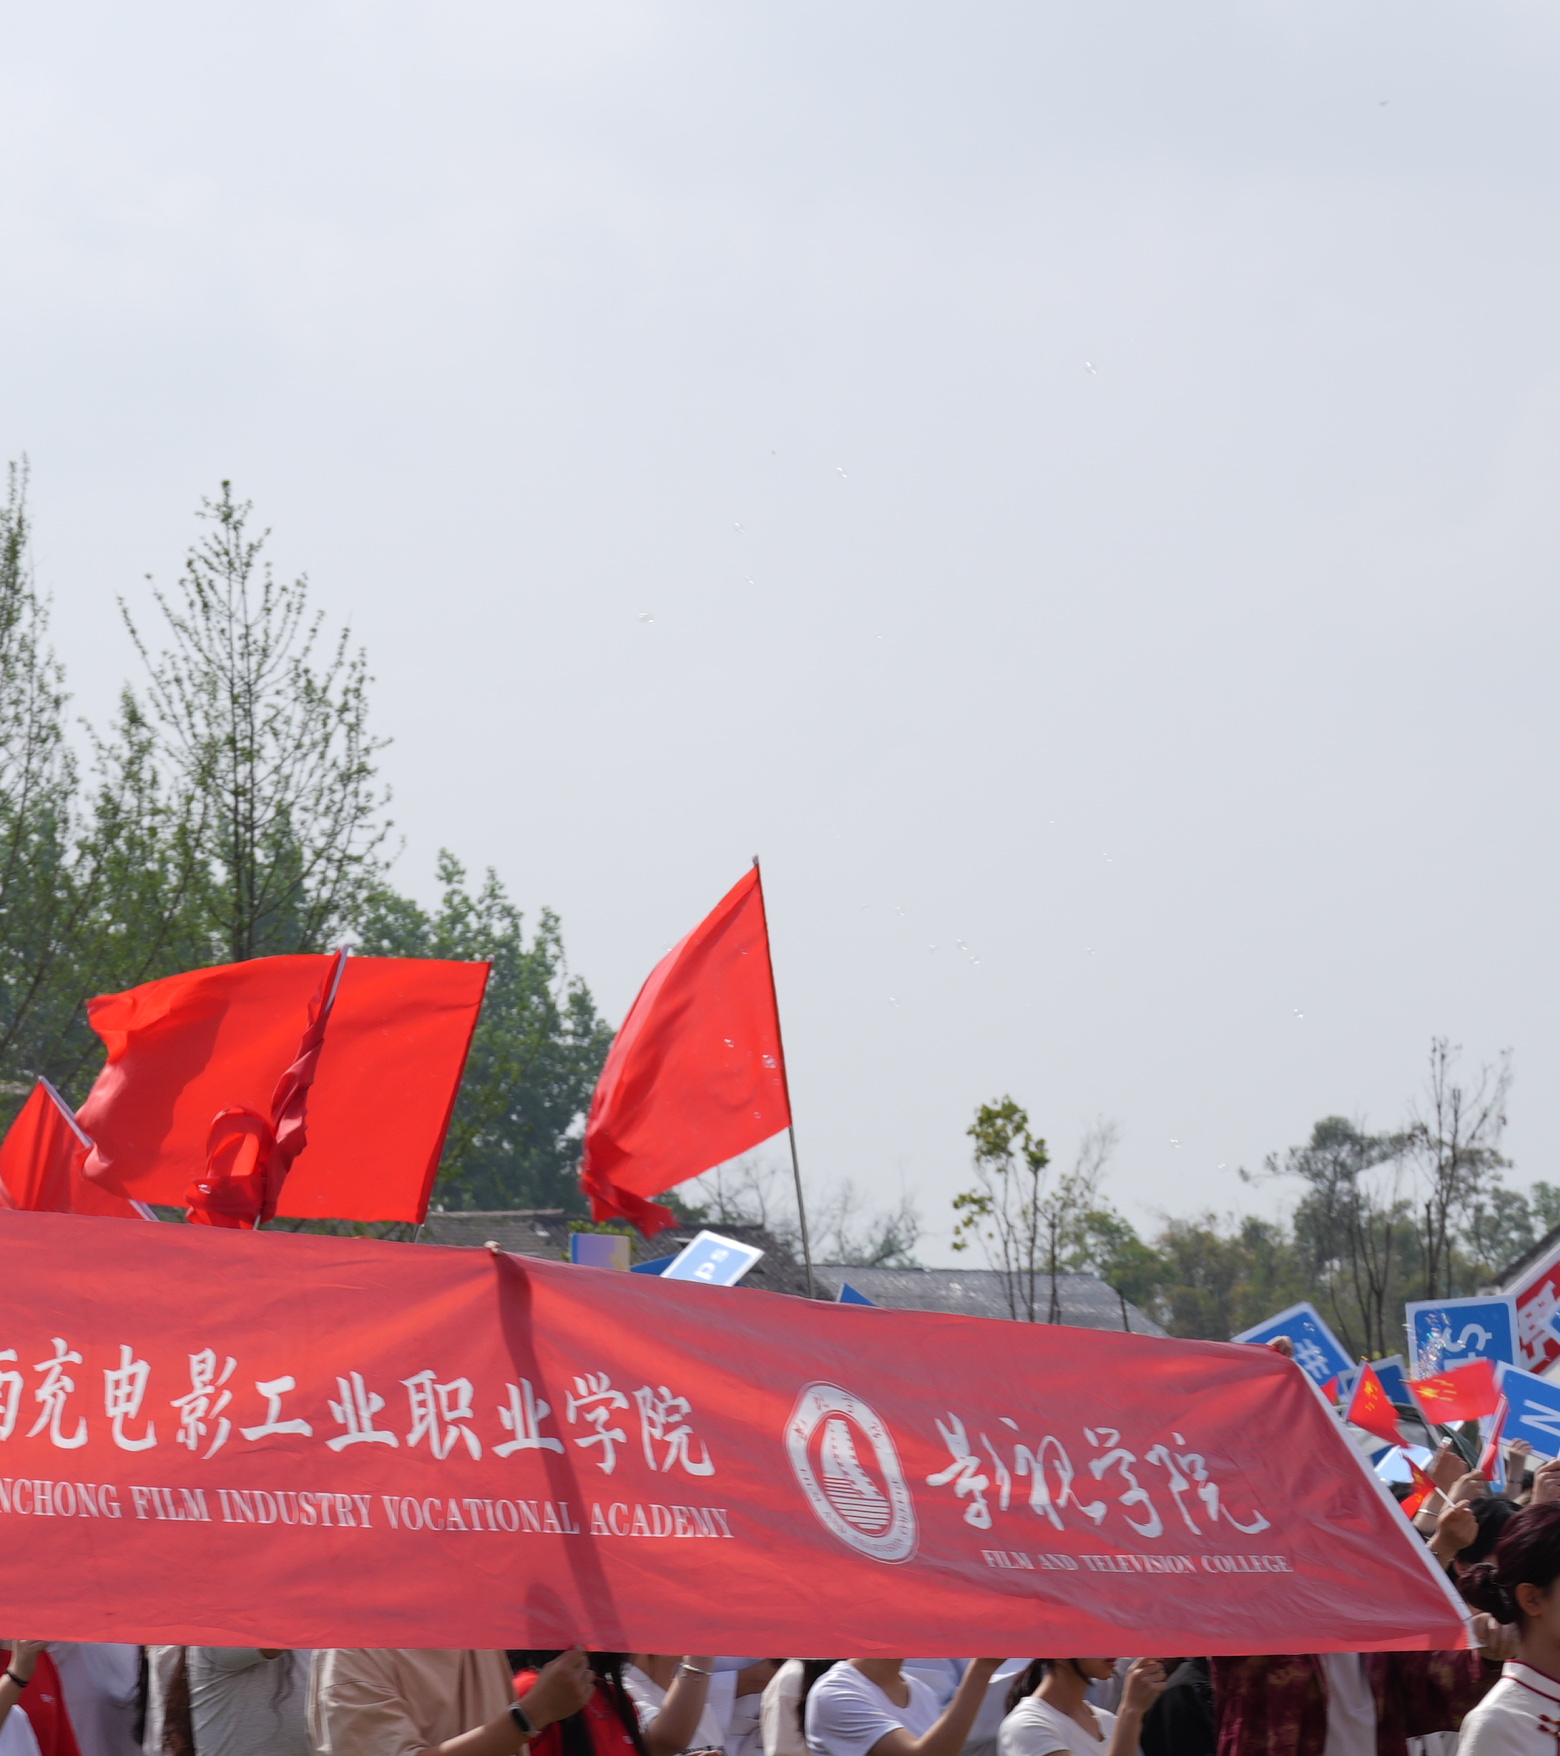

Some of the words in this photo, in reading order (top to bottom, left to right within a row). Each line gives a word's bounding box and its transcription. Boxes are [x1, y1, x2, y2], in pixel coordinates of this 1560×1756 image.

[925, 1411, 1272, 1539] 影视学院
[128, 1485, 213, 1522] FILM
[215, 1489, 373, 1529] INDUSTRY
[381, 1495, 580, 1535] VOCATIONAL
[589, 1502, 735, 1539] ACADEMY
[980, 1549, 1036, 1570] FILM
[1037, 1553, 1079, 1571] AND
[1079, 1554, 1198, 1574] TELEVISION
[1200, 1555, 1295, 1574] COLLEGE
